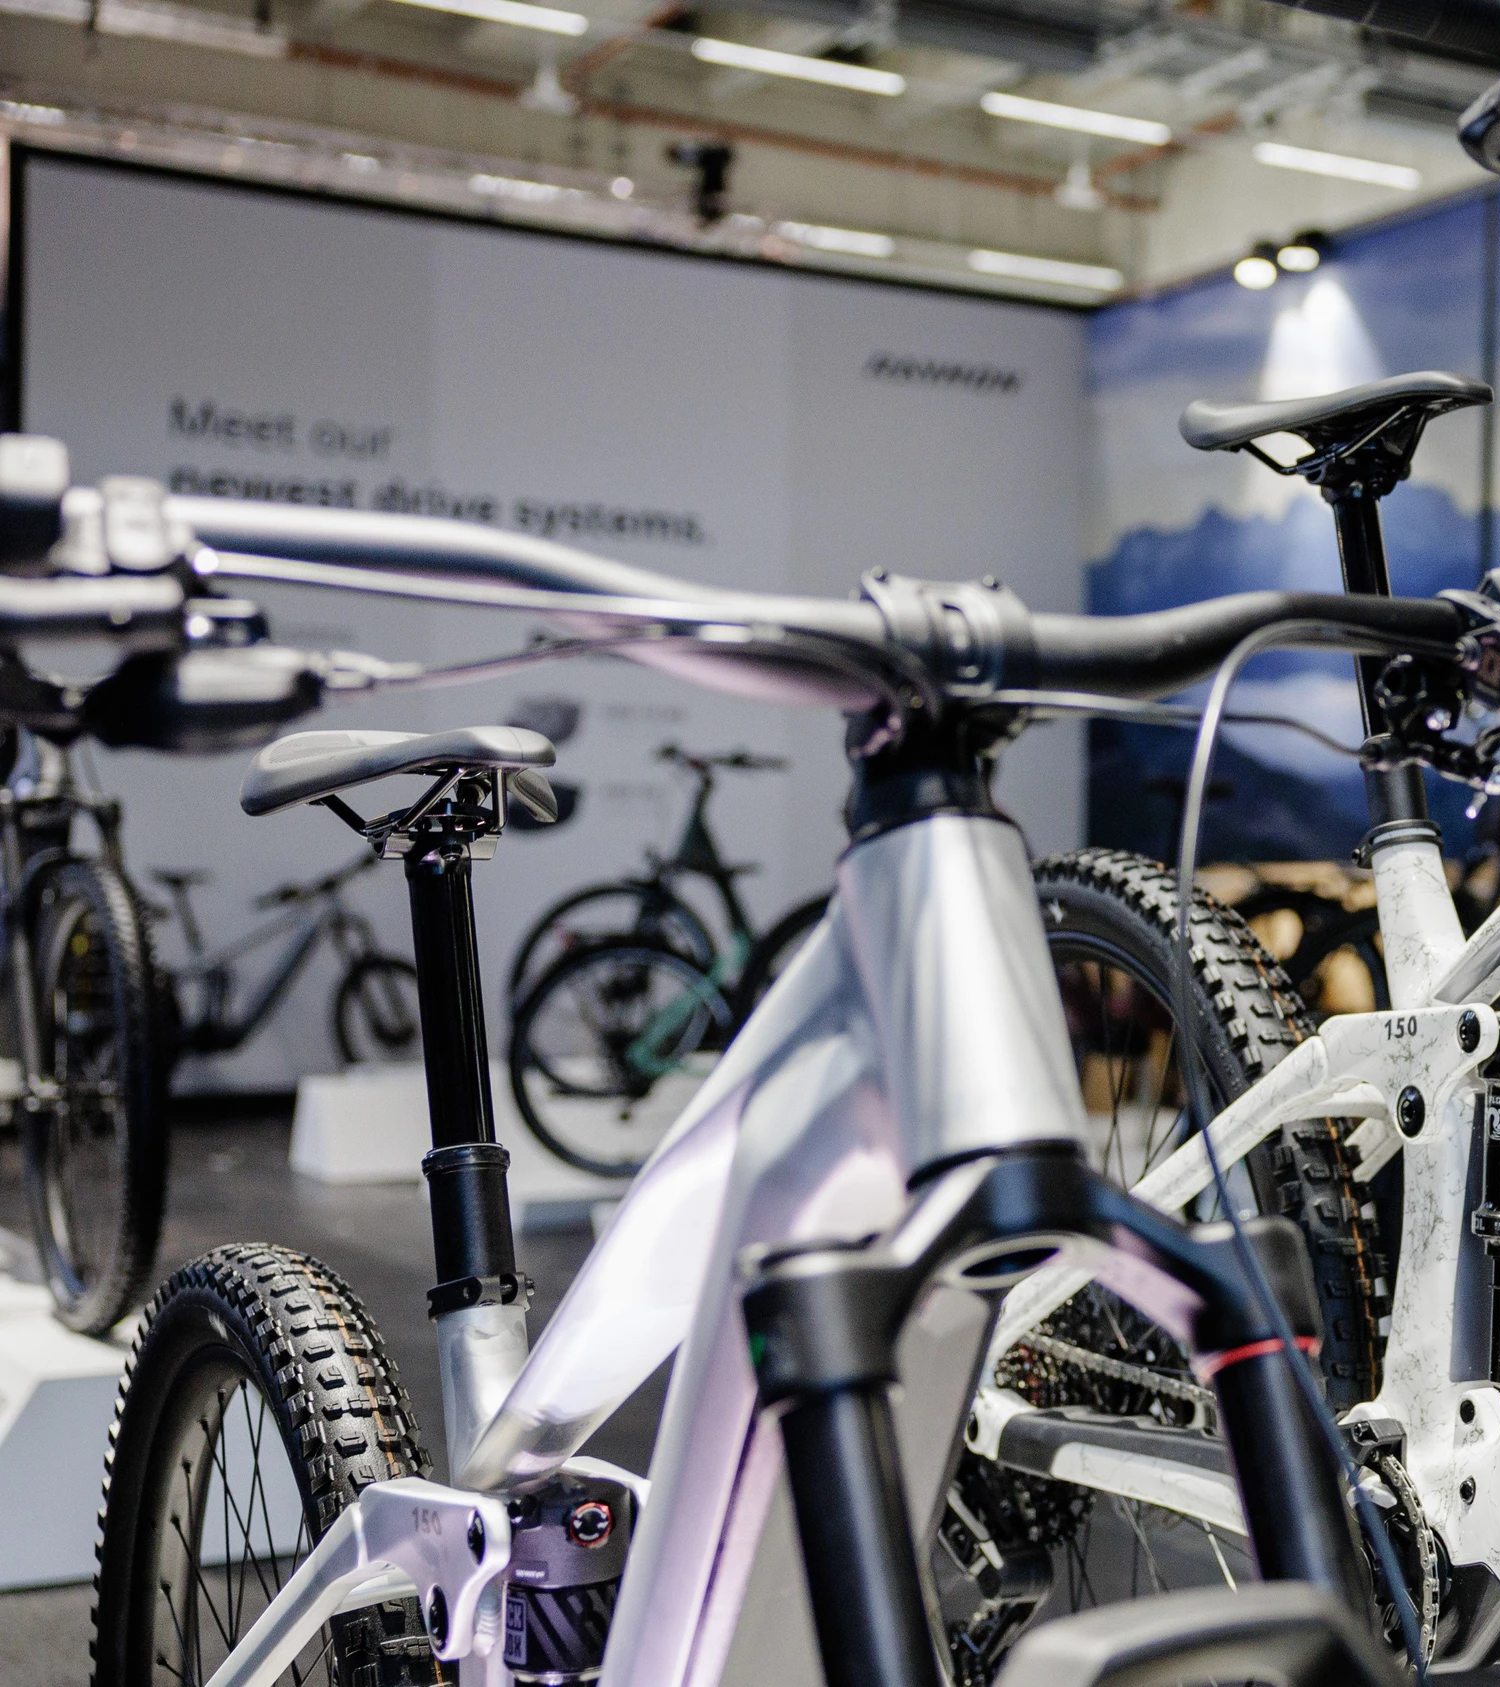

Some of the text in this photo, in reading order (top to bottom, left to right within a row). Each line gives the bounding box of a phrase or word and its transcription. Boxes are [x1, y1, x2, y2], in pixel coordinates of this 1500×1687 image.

[169, 398, 393, 459] Meet our
[1384, 1015, 1418, 1041] 150
[411, 1506, 443, 1536] 150
